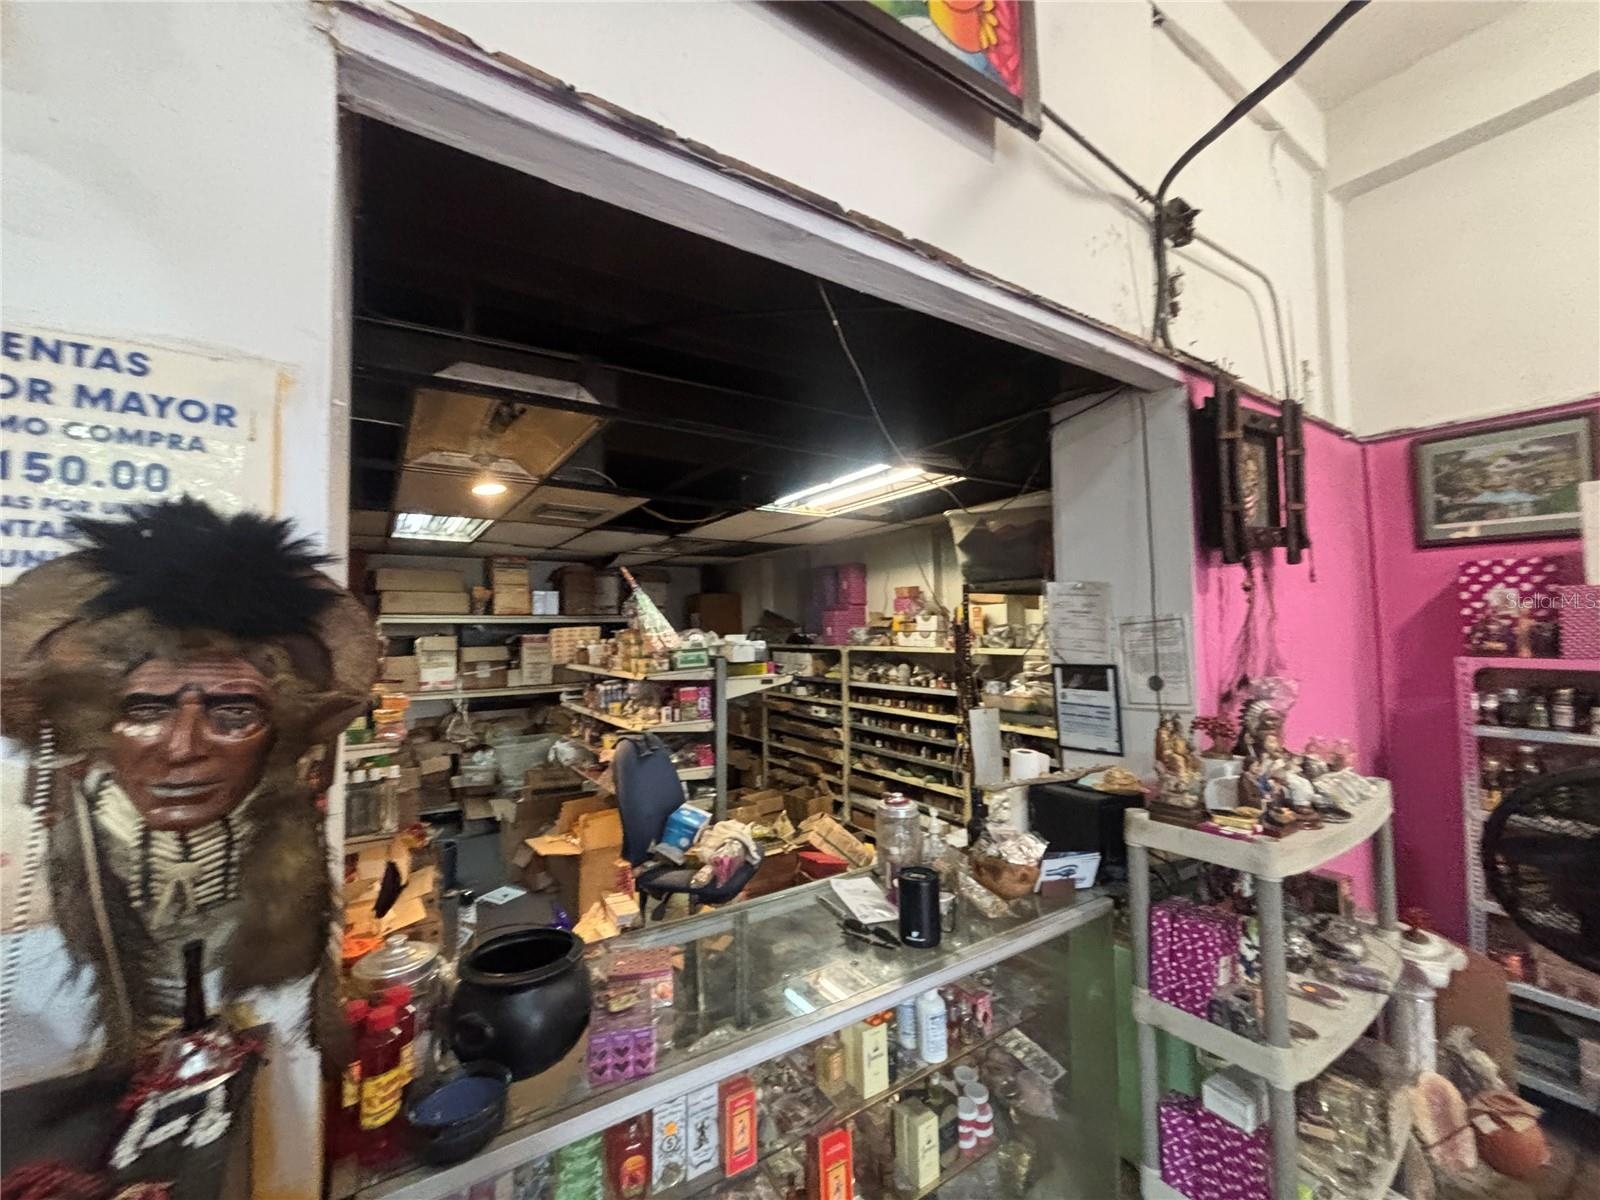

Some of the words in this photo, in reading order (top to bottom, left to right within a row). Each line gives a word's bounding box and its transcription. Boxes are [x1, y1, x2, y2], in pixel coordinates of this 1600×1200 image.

[1, 331, 152, 377] ENTAS
[75, 384, 237, 428] MAYOR
[63, 421, 206, 453] COMPRA
[0, 450, 170, 492] 150.00
